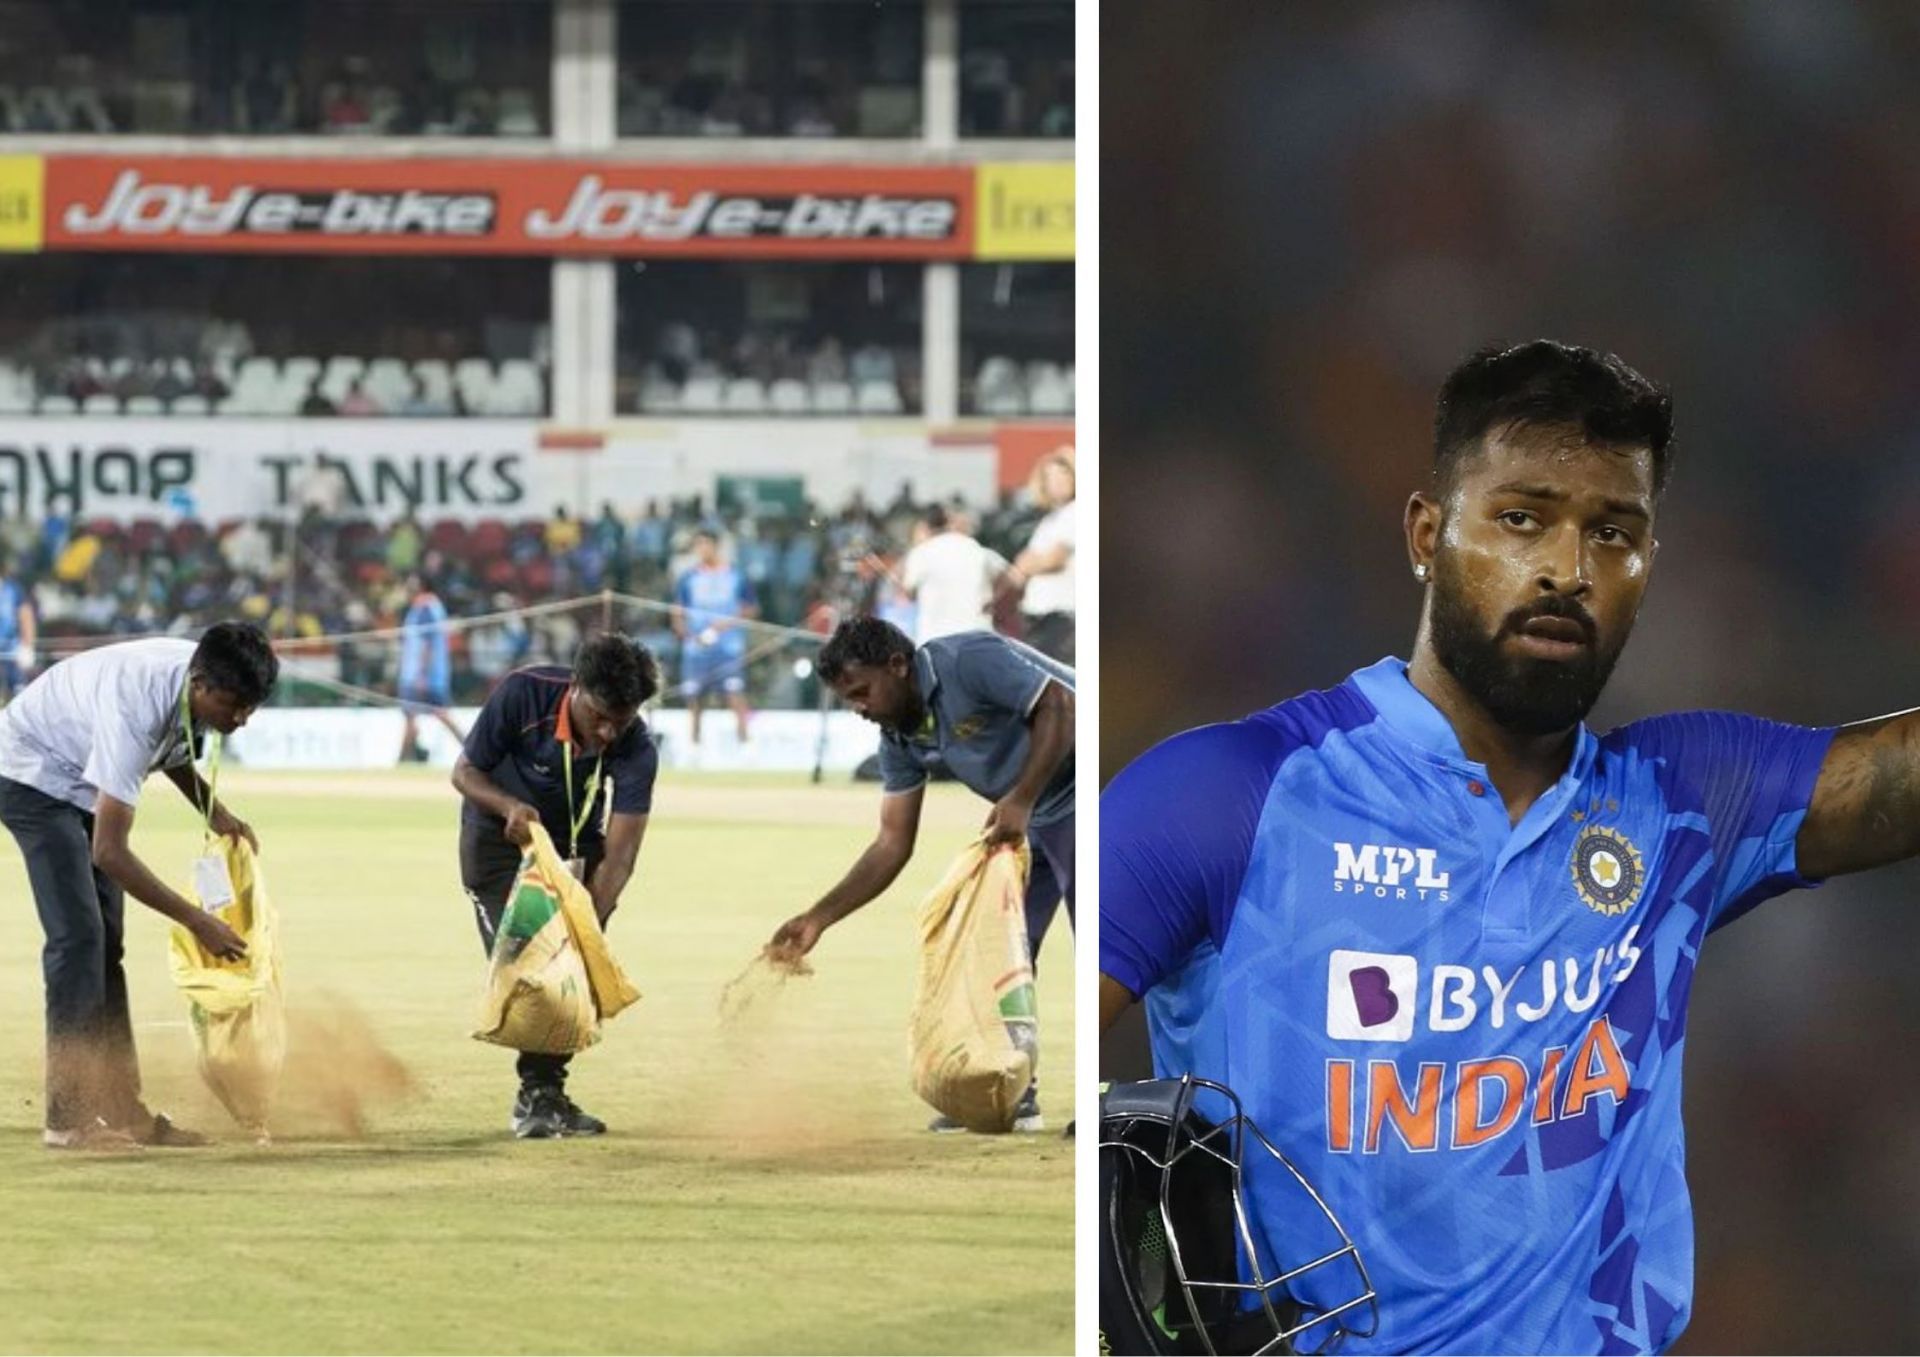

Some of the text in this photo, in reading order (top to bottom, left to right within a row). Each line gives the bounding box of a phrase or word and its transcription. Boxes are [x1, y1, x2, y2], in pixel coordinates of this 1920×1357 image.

[1333, 842, 1449, 888] MPL
[1334, 883, 1449, 901] SPORTS
[1429, 924, 1641, 1032] BYJU'S
[1326, 1013, 1632, 1155] INDIA
